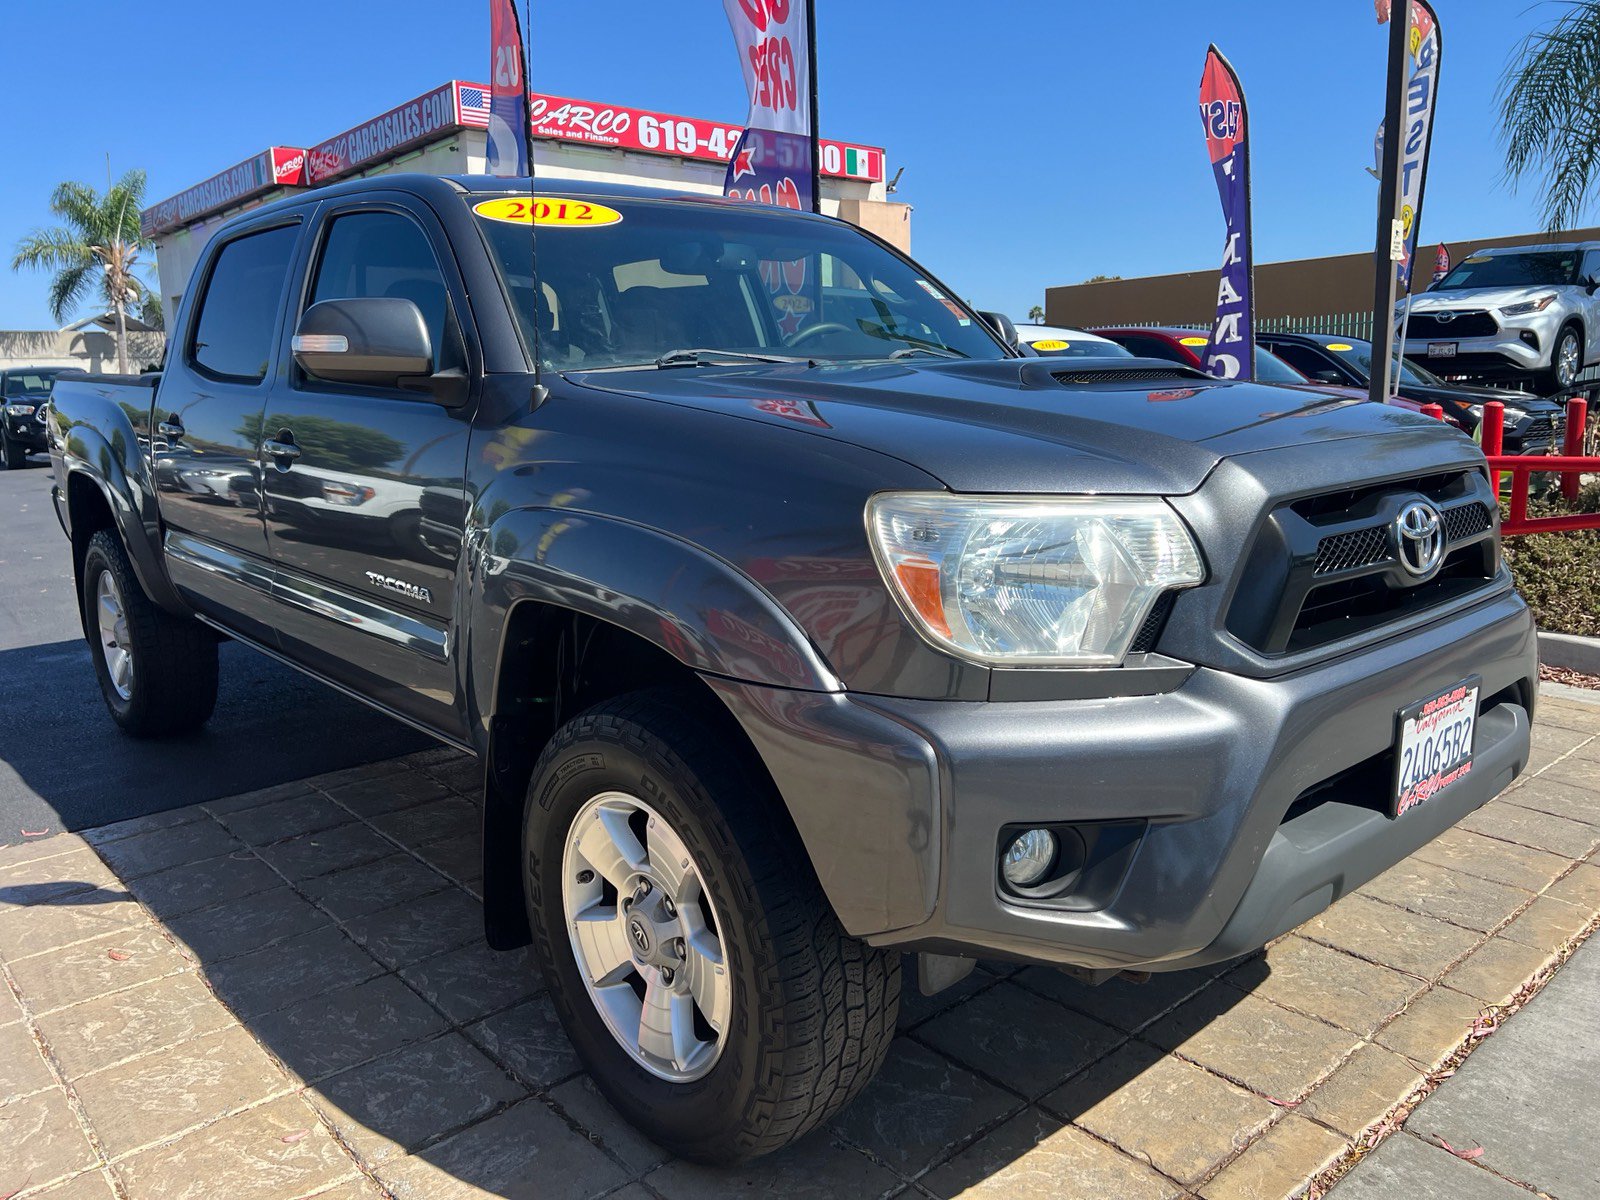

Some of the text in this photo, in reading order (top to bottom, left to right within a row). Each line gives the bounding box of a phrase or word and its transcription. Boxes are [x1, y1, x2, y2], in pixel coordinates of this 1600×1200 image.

[349, 88, 454, 164] CARCOSALES.COM
[531, 99, 630, 136] CARCO
[538, 126, 619, 144] Sales and Finance
[275, 155, 303, 177] CARCO
[507, 202, 593, 220] 2012
[365, 571, 431, 604] TACOMA
[1400, 716, 1471, 793] 24065B2
